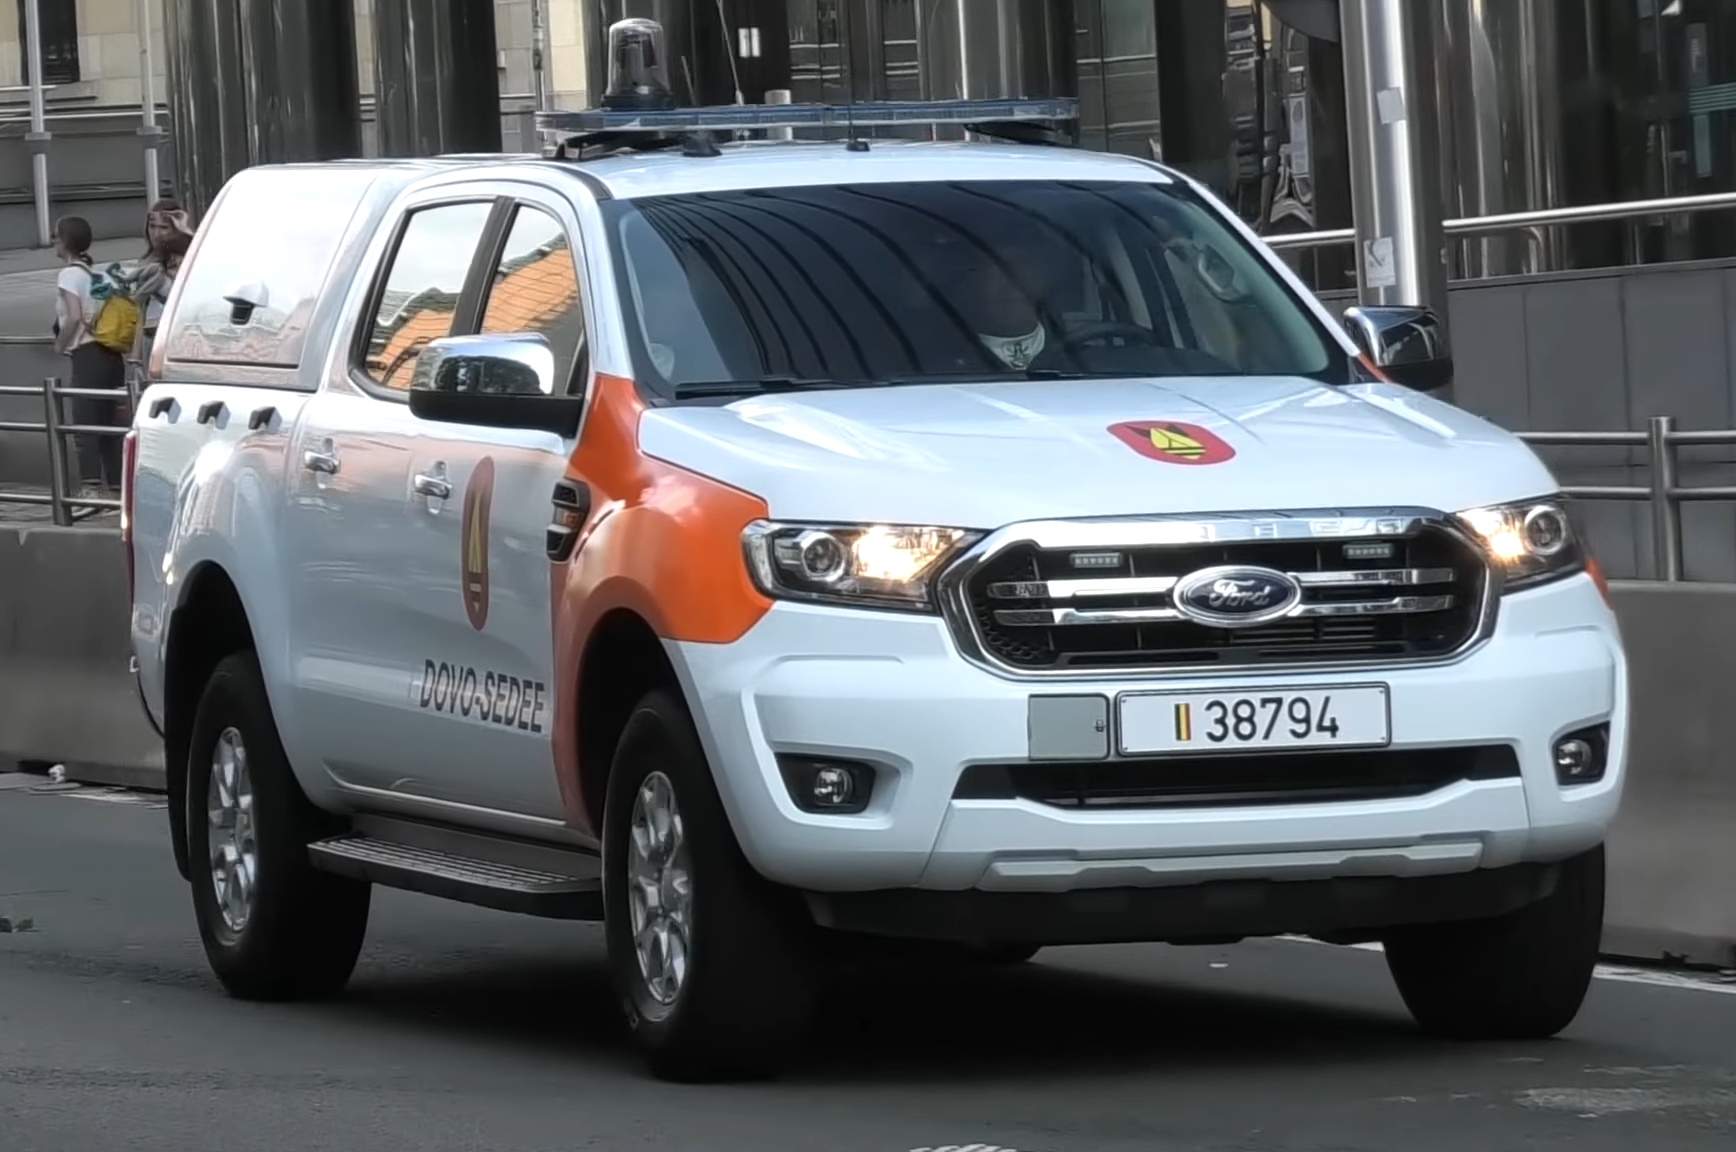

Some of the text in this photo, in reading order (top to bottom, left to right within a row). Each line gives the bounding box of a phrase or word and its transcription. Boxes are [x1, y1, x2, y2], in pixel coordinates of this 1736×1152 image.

[1208, 579, 1271, 607] Ford
[420, 659, 545, 733] DOVO-SEDEE
[1204, 695, 1339, 743] 38794
